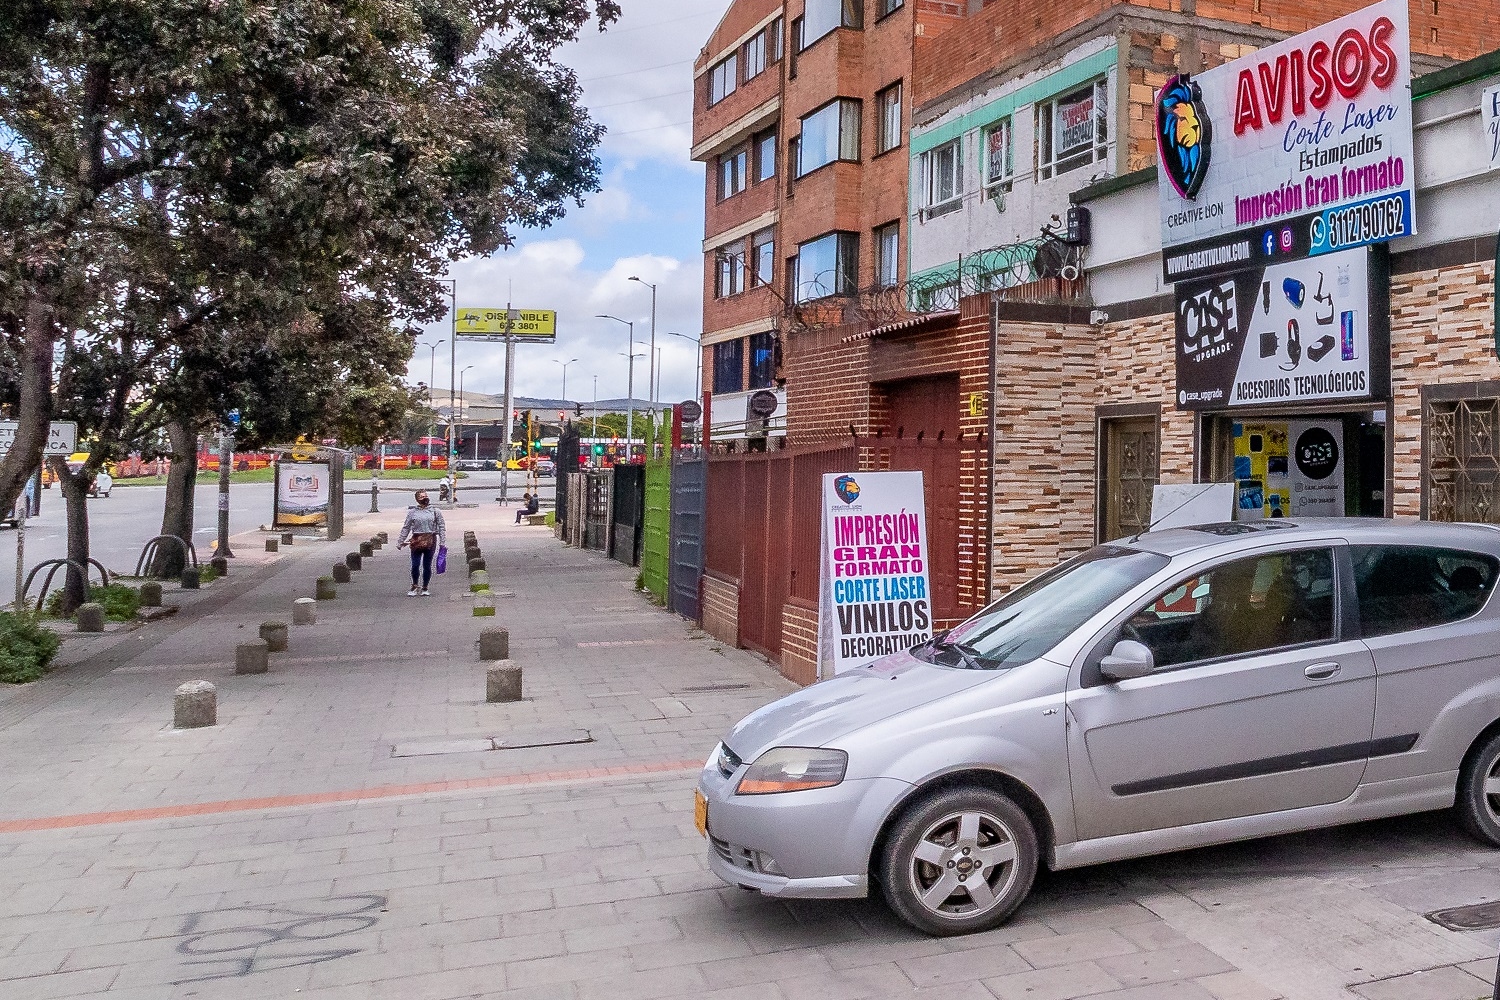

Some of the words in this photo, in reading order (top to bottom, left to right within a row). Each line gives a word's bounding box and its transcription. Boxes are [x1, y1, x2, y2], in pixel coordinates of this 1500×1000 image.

[1233, 16, 1398, 137] AVISOS
[1066, 110, 1089, 128] LOCAL
[1283, 111, 1334, 152] Corte
[1341, 102, 1398, 134] Laser
[1299, 133, 1383, 172] Estampados
[1235, 179, 1302, 226] Impresión
[1305, 174, 1340, 208] Gran
[1341, 155, 1404, 199] formato
[1167, 207, 1203, 228] CREATIVE
[1205, 201, 1224, 219] LION
[1328, 196, 1404, 247] 3112790762
[486, 312, 550, 322] DISPNIBLE
[1180, 280, 1239, 354] CASE
[1236, 378, 1291, 401] ACCESORIOS
[1294, 370, 1366, 396] TECNOLÓGICOS
[834, 508, 920, 547] IMPRESIÓN
[833, 545, 921, 562] GRAN
[835, 559, 923, 577] FORMATO
[834, 578, 881, 604] CORTE
[883, 576, 926, 601] LASER
[836, 600, 929, 635] VINILOS
